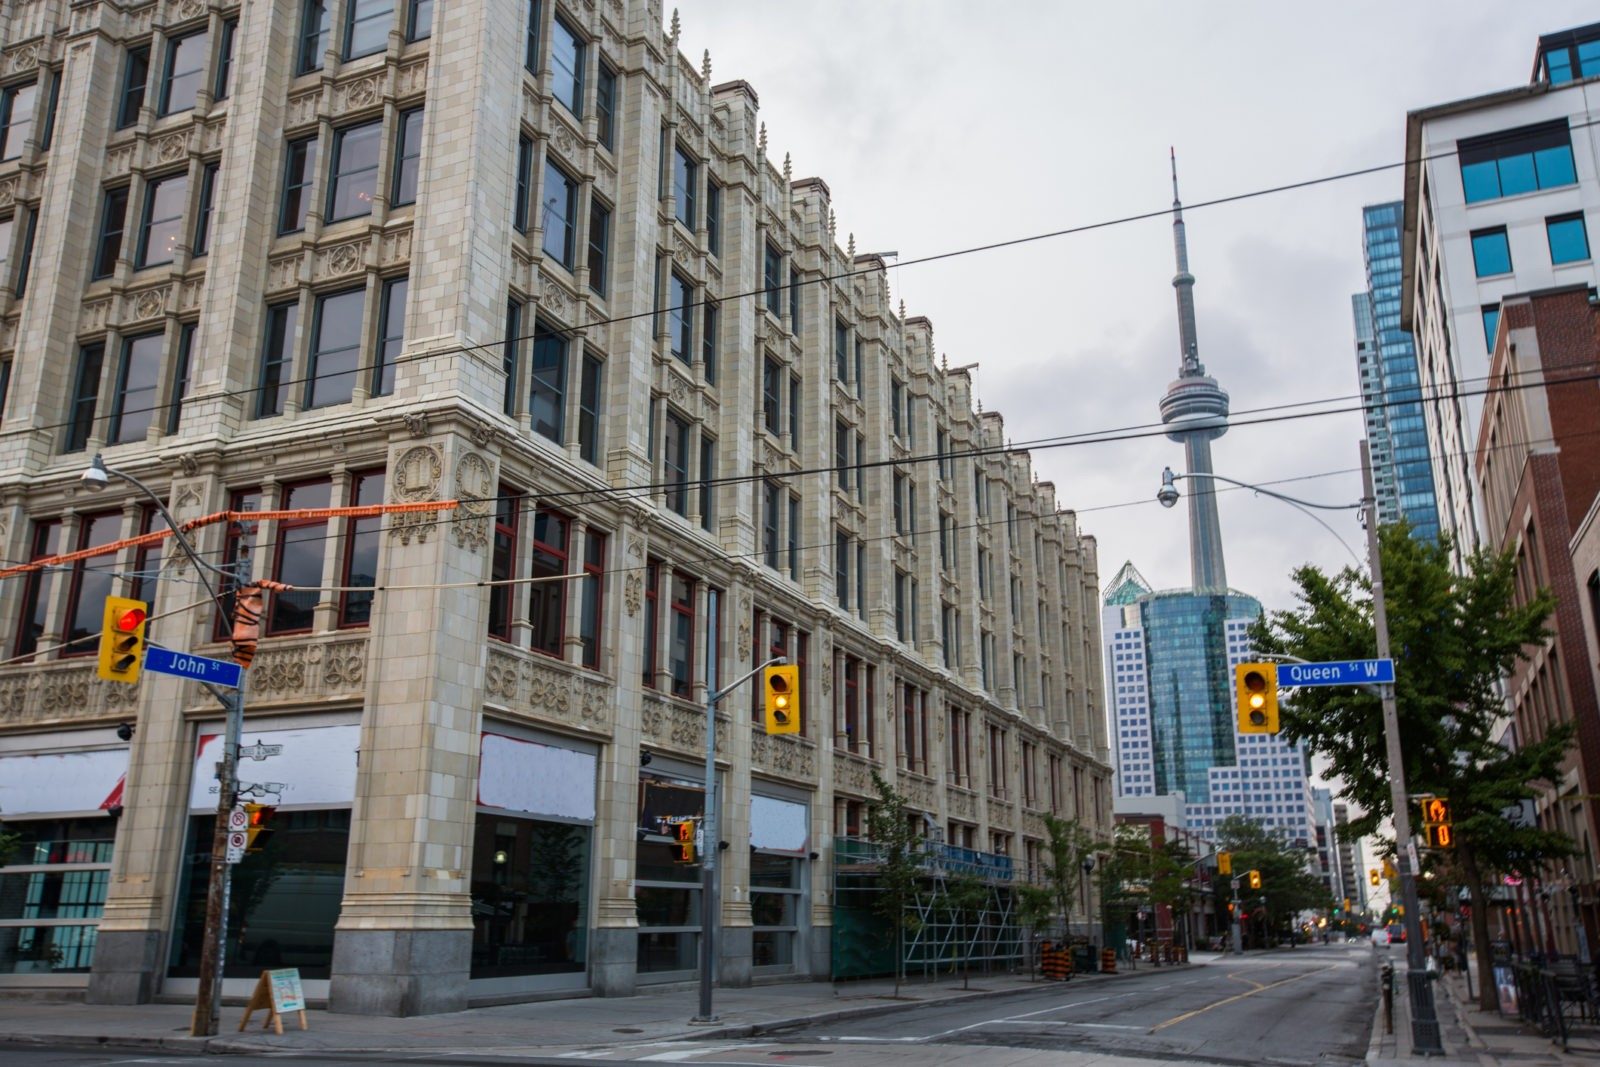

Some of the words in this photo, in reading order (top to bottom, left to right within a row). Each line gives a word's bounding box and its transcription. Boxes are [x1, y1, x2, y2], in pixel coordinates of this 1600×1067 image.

[169, 654, 206, 674] John
[212, 662, 220, 671] St
[1291, 665, 1340, 681] Queen
[1348, 662, 1359, 672] St
[1364, 662, 1378, 677] W
